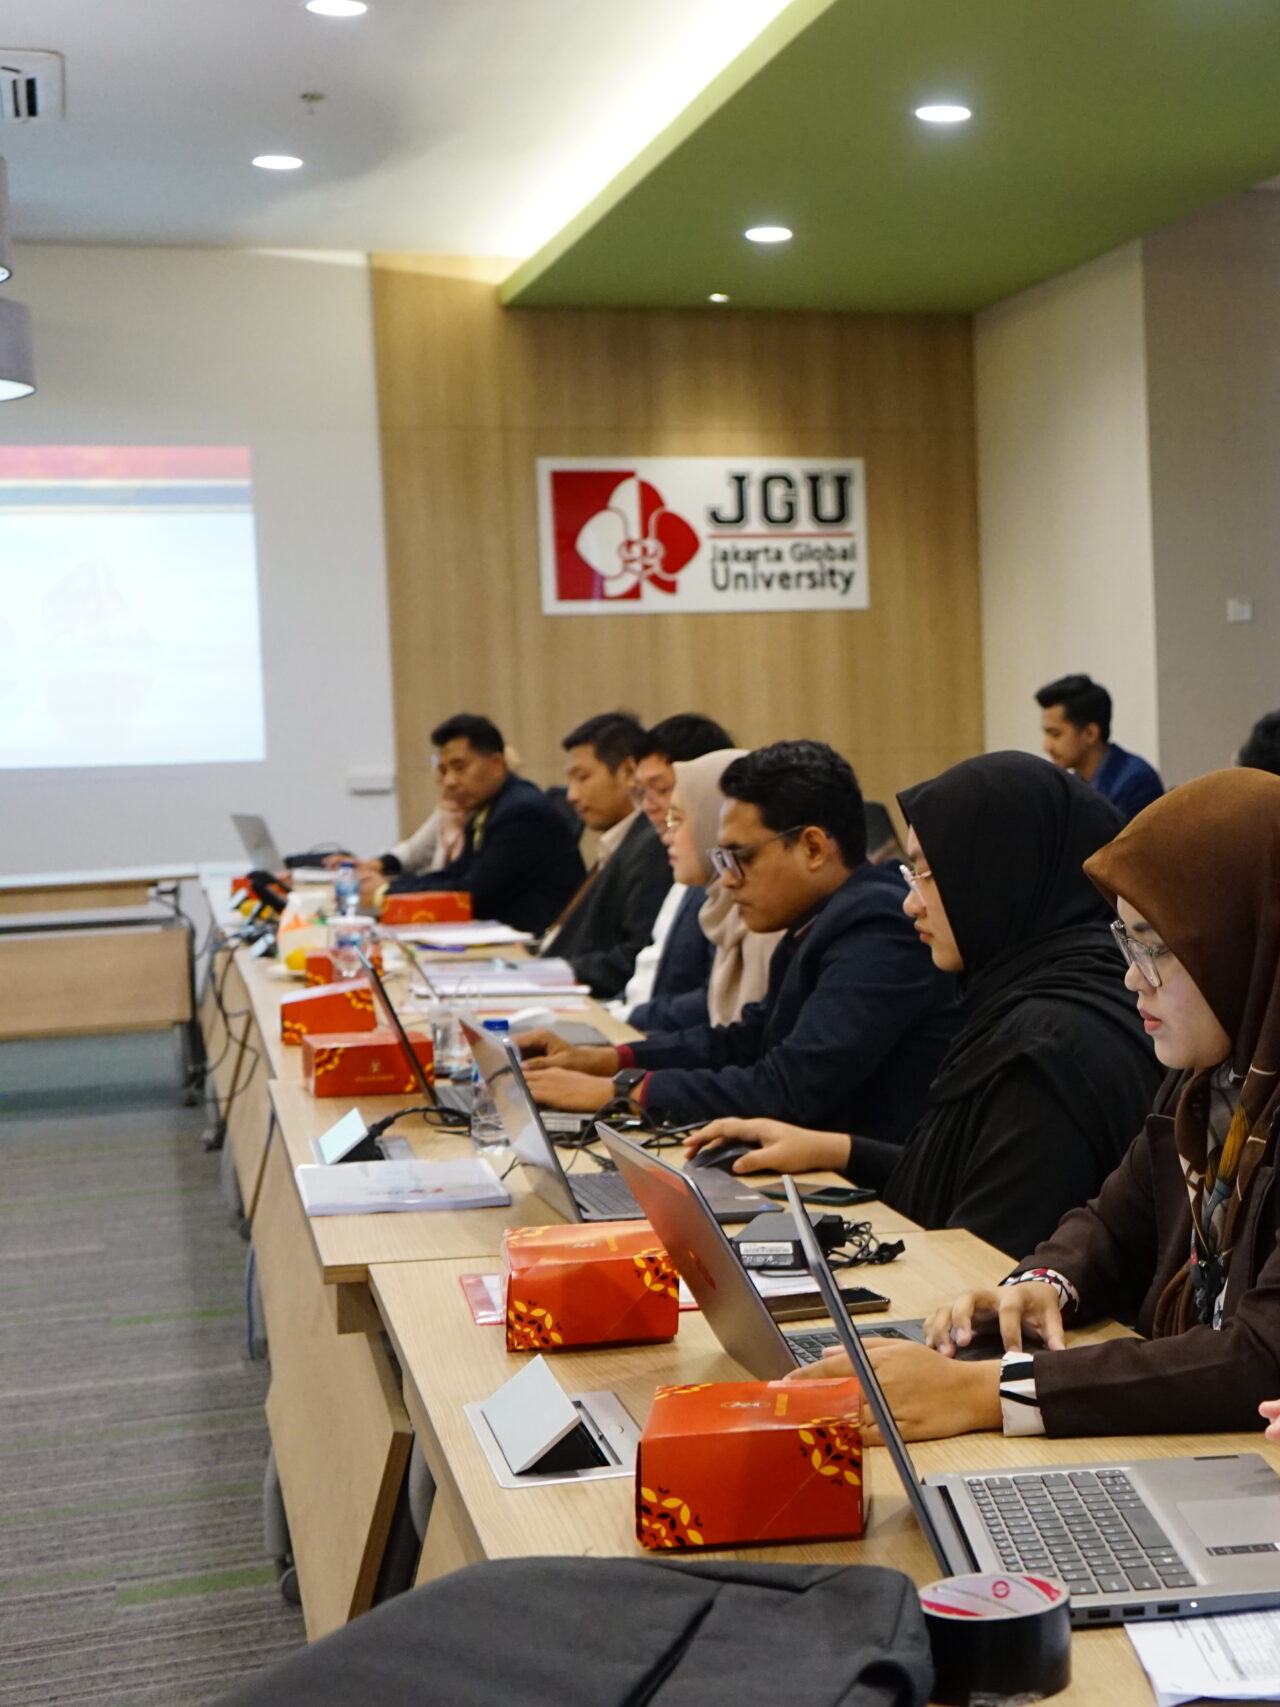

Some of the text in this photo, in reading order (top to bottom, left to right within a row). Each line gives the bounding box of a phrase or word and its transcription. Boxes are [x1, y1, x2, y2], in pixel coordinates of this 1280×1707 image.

[709, 471, 853, 528] JGU
[789, 543, 856, 563] Global
[711, 566, 855, 596] University
